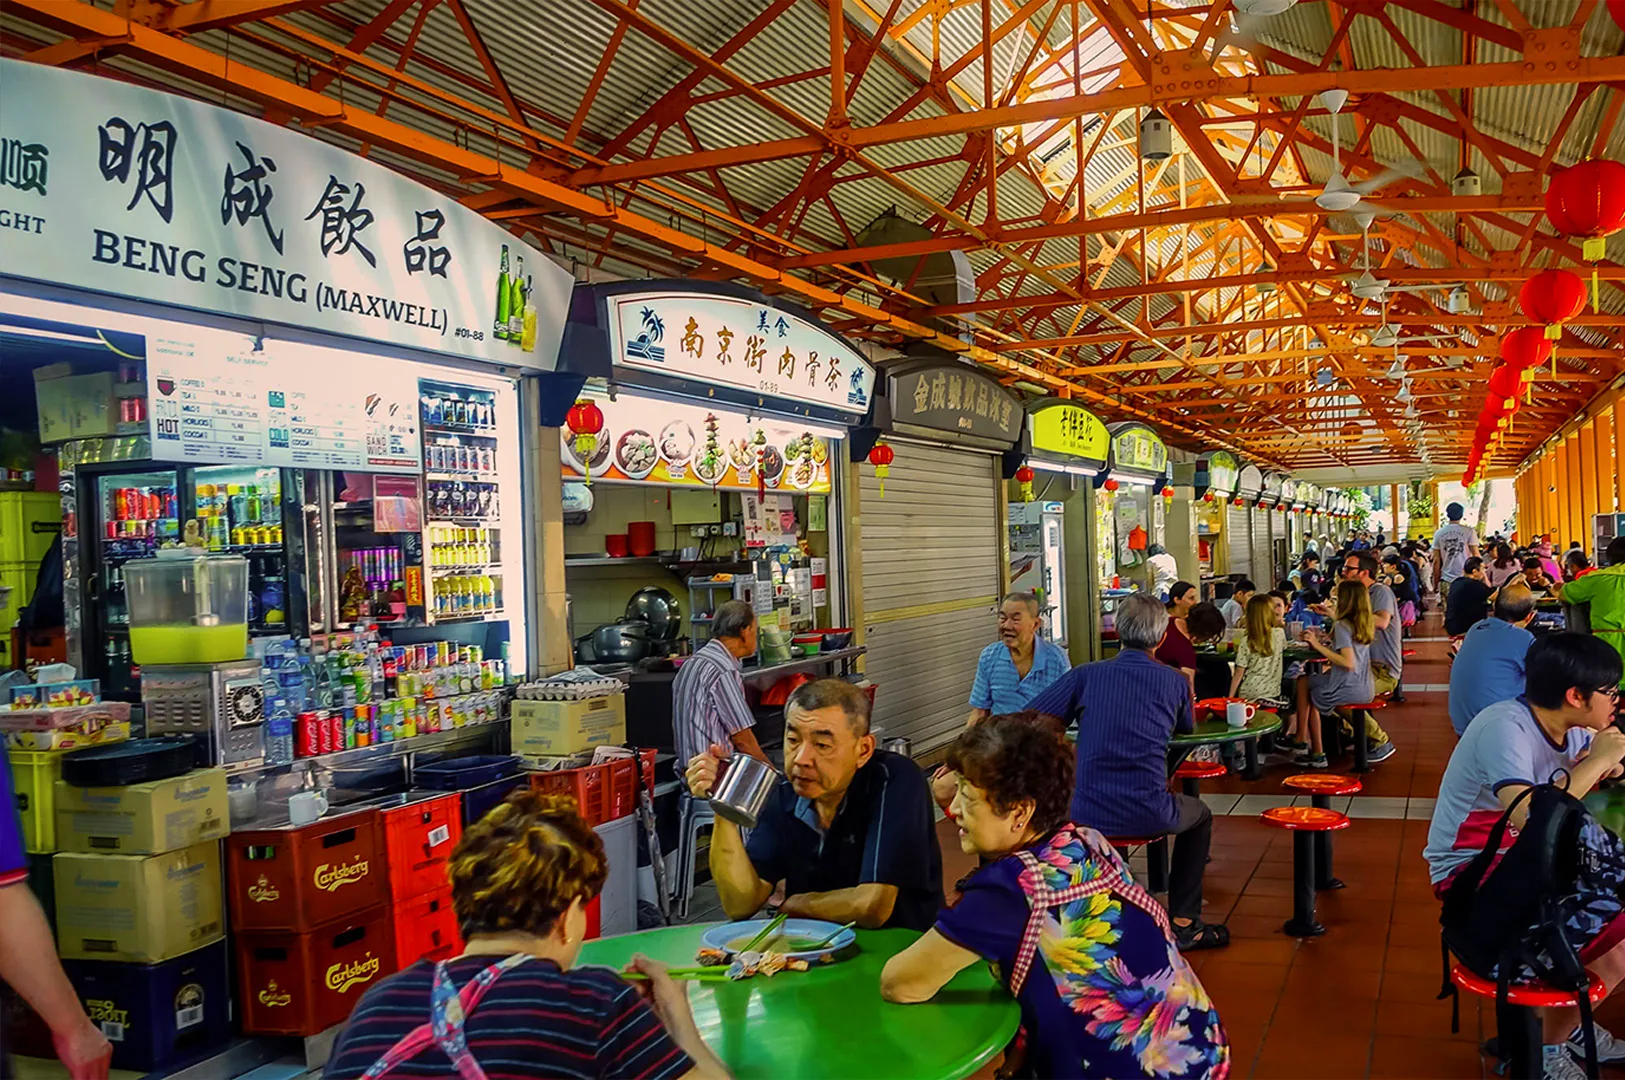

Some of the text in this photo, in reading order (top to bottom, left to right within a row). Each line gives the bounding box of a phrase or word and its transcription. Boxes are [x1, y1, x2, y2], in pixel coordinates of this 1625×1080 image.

[92, 229, 449, 336] BENG SENG (MAXWELL)
[455, 328, 484, 341] #01-88
[756, 310, 790, 338] 美食
[680, 315, 843, 393] 南京街肉骨茶
[156, 418, 180, 434] HOT
[314, 860, 368, 892] Carlsberg
[325, 957, 379, 993] Carlsberg
